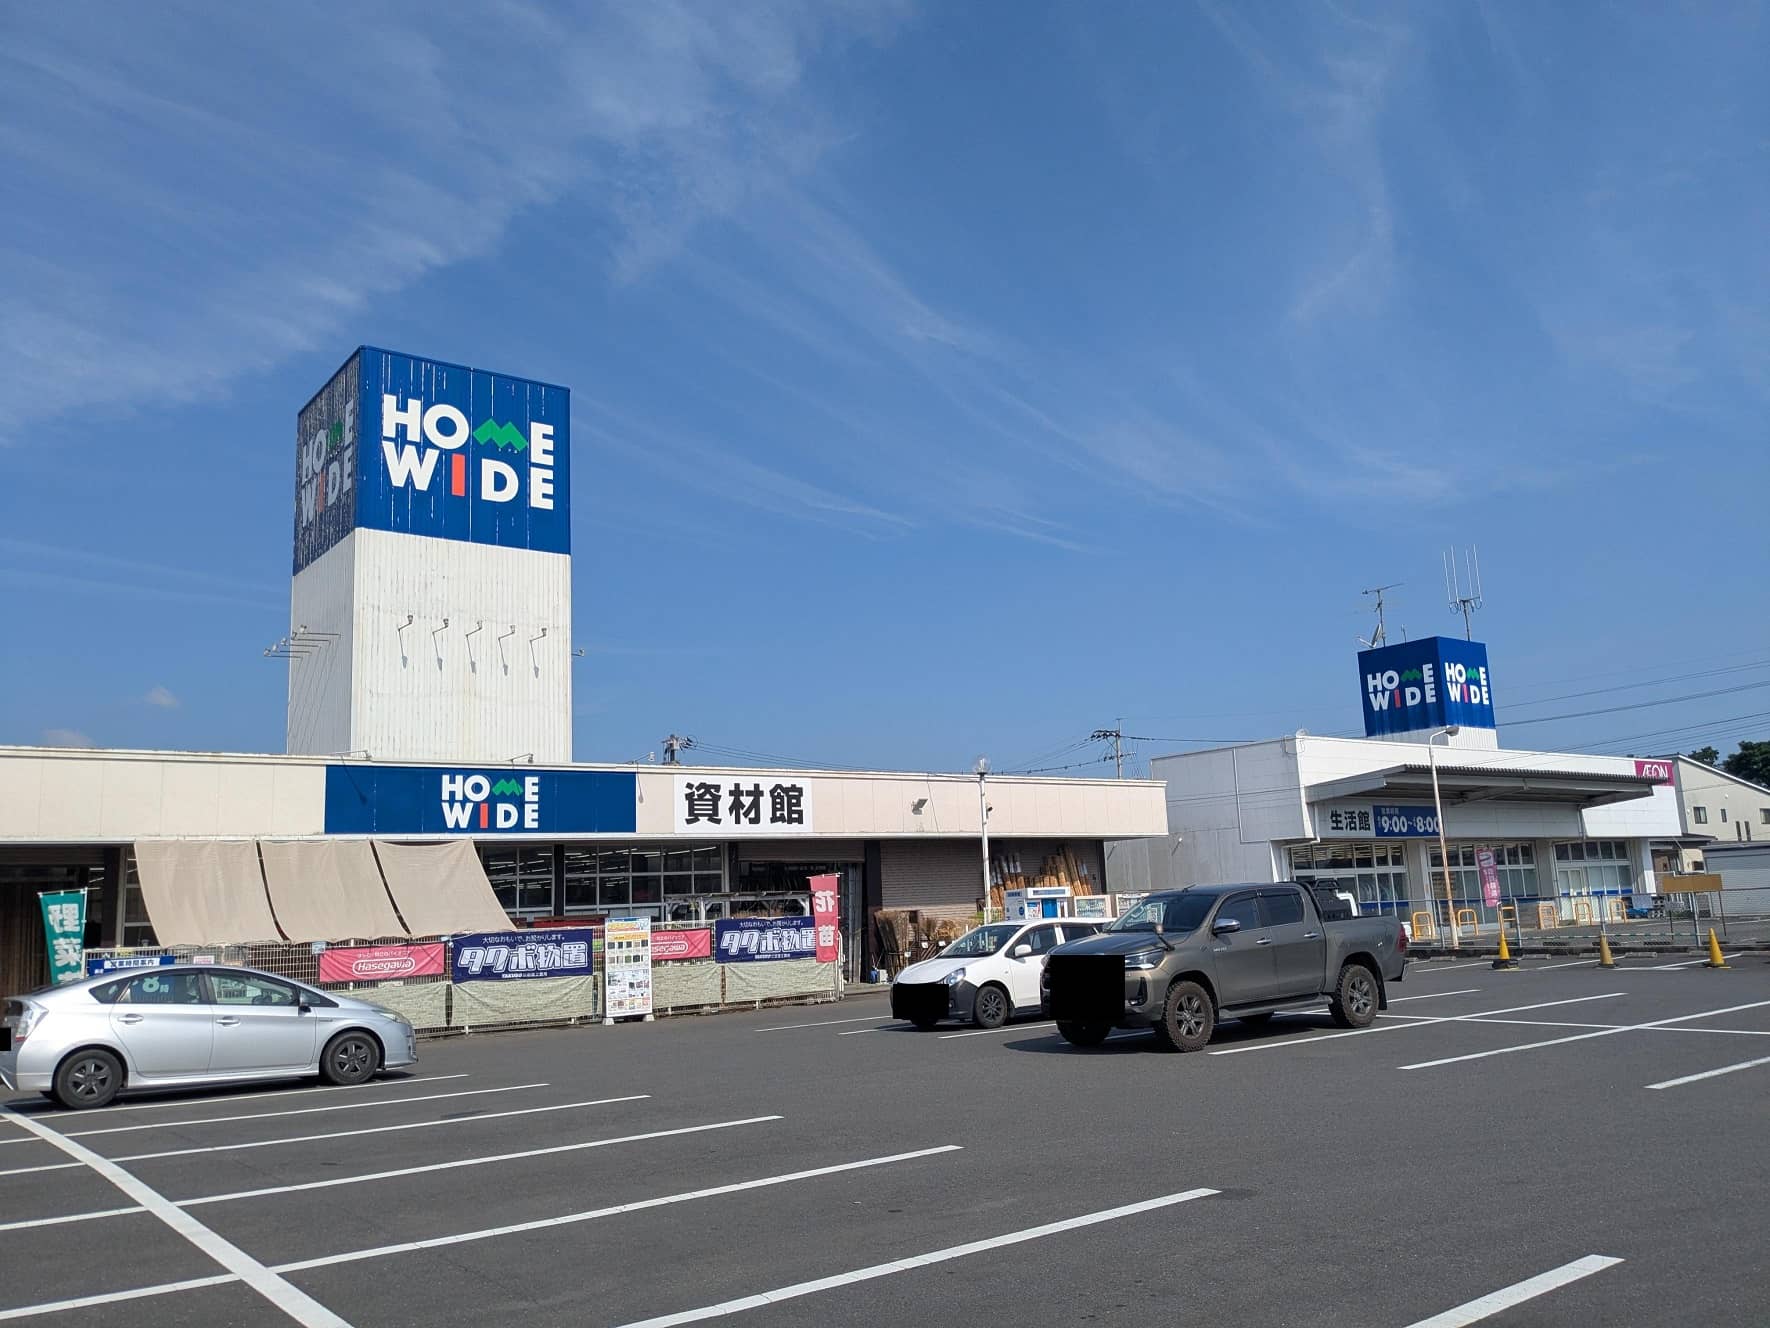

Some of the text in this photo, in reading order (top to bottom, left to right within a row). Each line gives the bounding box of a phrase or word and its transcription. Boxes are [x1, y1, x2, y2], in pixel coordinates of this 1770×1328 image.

[302, 399, 353, 486] HOME
[383, 393, 554, 466] HOME
[302, 447, 353, 527] WIDE
[382, 441, 554, 510] WIDE
[1367, 663, 1433, 692] HOME
[1445, 662, 1487, 685] HOME
[1369, 684, 1437, 711] WIDE
[1447, 682, 1489, 705] WIDE
[442, 775, 539, 801] HOME
[442, 803, 539, 829] WIDE
[685, 781, 804, 825] 資材館
[1330, 810, 1371, 832] 生活館
[457, 942, 588, 974] タクボ物置
